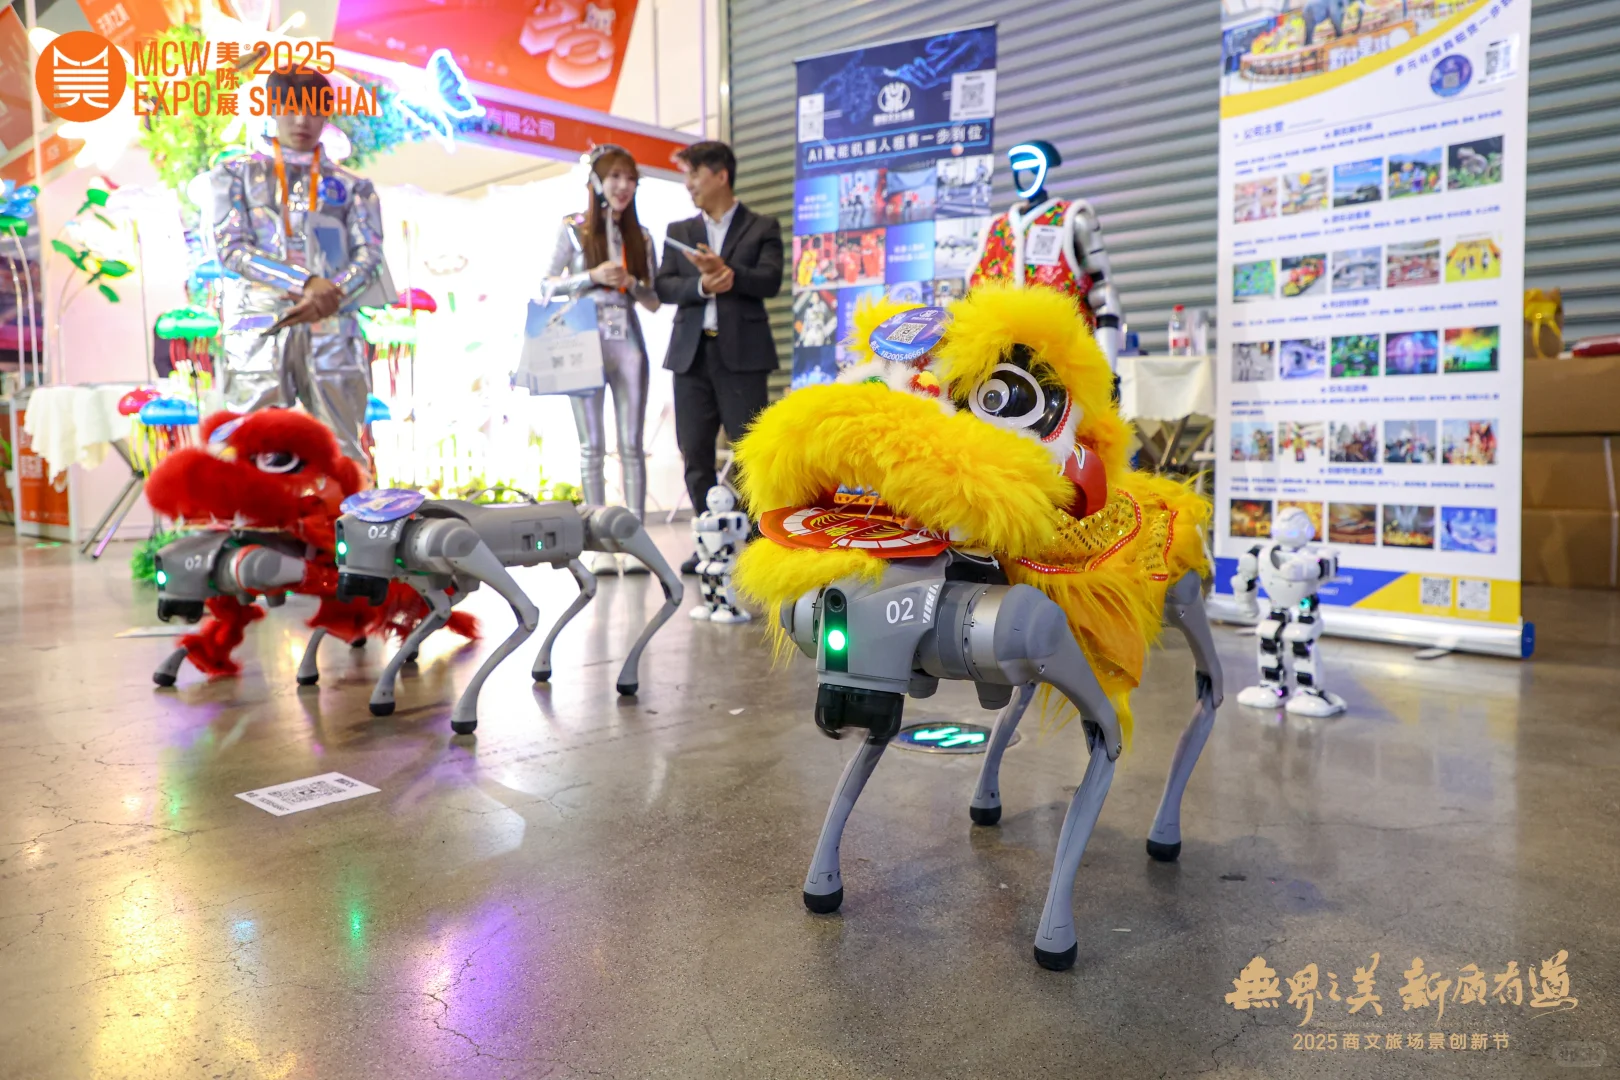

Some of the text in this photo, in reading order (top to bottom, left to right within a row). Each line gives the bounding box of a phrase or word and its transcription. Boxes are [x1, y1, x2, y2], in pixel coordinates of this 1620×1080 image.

[367, 526, 387, 539] 02
[185, 556, 201, 570] 02
[886, 597, 914, 624] 02
